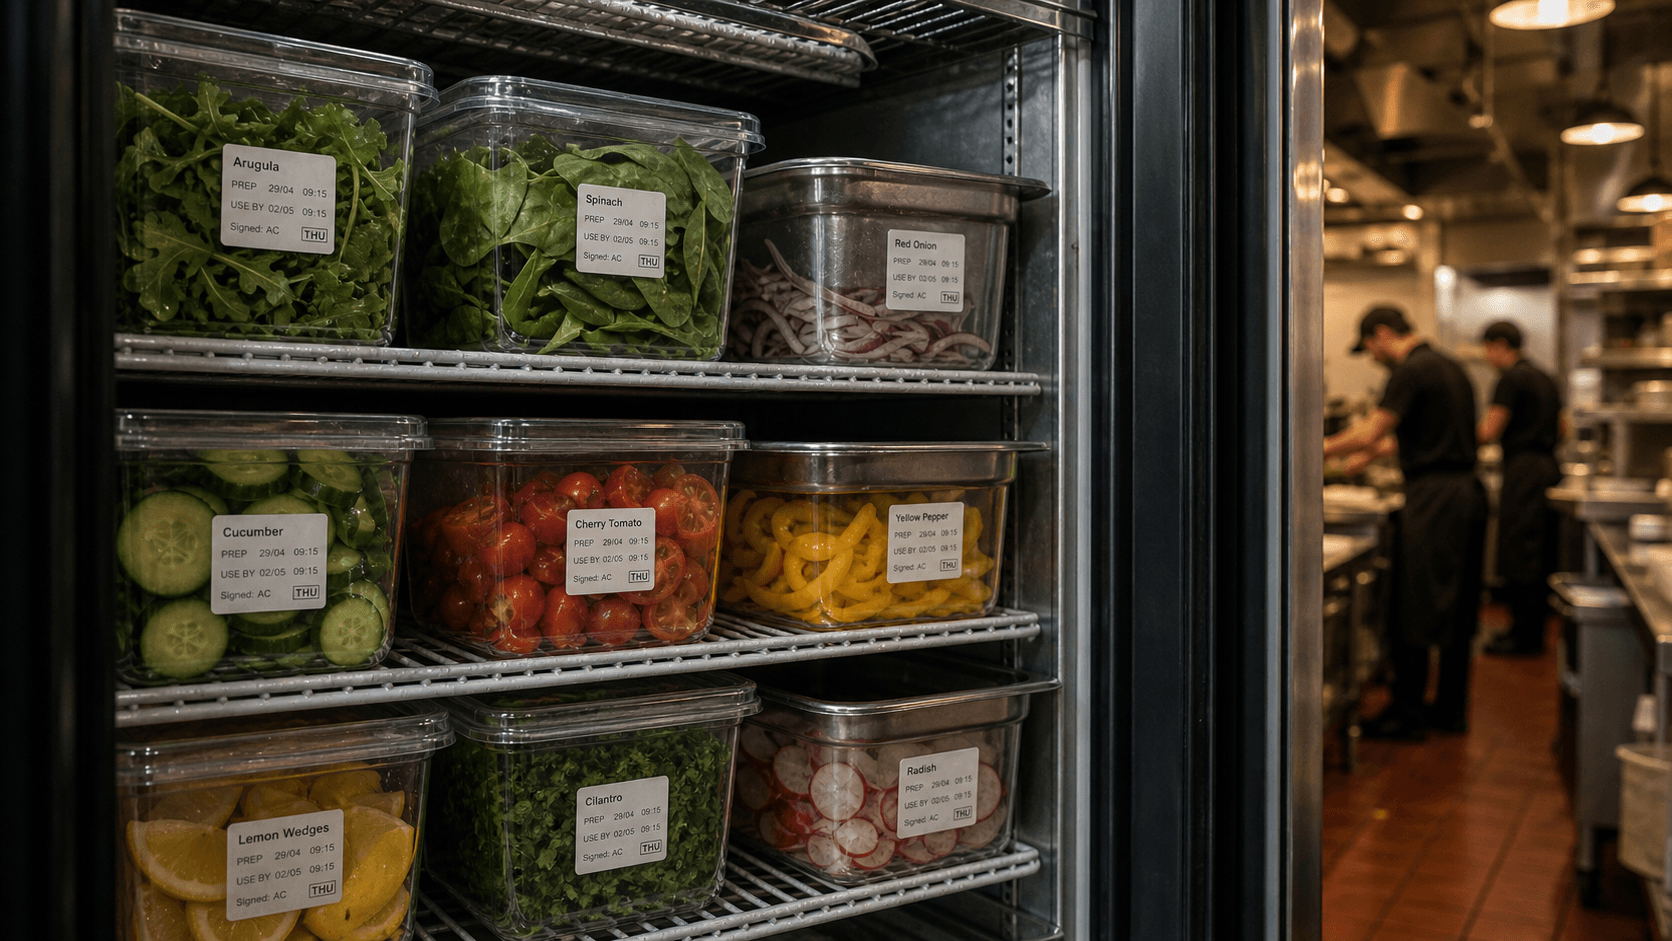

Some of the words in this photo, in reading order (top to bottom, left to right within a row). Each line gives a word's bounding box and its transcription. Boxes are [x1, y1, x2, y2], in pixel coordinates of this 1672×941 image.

[233, 157, 279, 172] Arugula
[231, 180, 257, 190] PREP
[268, 184, 294, 194] 29/04
[302, 188, 327, 198] 09:15
[586, 194, 623, 207] Spinach
[230, 201, 250, 210] USE
[252, 203, 264, 211] BY
[268, 205, 294, 214] 02/05
[302, 208, 327, 218] 09:15
[230, 222, 263, 234] Signed:
[266, 226, 280, 234] AC
[584, 215, 604, 223] PREP
[639, 221, 659, 229] 09:15
[304, 230, 325, 240] THU
[584, 233, 599, 241] USE
[613, 236, 633, 244] 02/05
[639, 238, 659, 246] 09:15
[894, 239, 911, 248] Red
[913, 240, 937, 250] Onion
[584, 252, 609, 261] Signed:
[641, 257, 658, 266] THU
[893, 257, 911, 265] PREP
[941, 260, 959, 268] 0915
[895, 514, 921, 522] Yellow
[923, 512, 949, 523] Pepper
[575, 519, 606, 530] Cherry
[609, 518, 642, 528] Tomato
[223, 527, 284, 538] Cucumber
[941, 529, 957, 537] 0915
[574, 539, 594, 547] PREP
[603, 538, 623, 546] 29/04
[629, 537, 649, 545] 09:15
[221, 550, 247, 558] PREP
[259, 549, 285, 557] 29/04
[294, 548, 318, 556] 09:15
[603, 555, 623, 563] 02/05
[221, 570, 240, 578] USE
[259, 568, 286, 577] 02/05
[293, 567, 318, 575] 09:15
[573, 575, 599, 584] Signed:
[221, 591, 254, 601] Signed:
[257, 590, 271, 598] AC
[296, 588, 317, 597] THU
[907, 764, 937, 776] Radish
[905, 784, 924, 793] PREP
[954, 775, 972, 785] 0915
[585, 794, 623, 806] Cilantro
[904, 801, 918, 809] USE
[920, 799, 928, 807] BY
[954, 791, 972, 800] 0915
[584, 815, 604, 825] PREP
[641, 806, 661, 816] 09:15
[956, 809, 970, 818] THU
[904, 816, 926, 827] Signed
[929, 814, 939, 822] AC
[239, 832, 279, 845] Lemon
[283, 824, 329, 838] Wedges
[583, 834, 599, 843] USE
[600, 832, 610, 841] BY
[614, 828, 635, 838] 02/05
[642, 842, 660, 852] THU
[236, 855, 263, 866] PREP
[310, 843, 335, 854] 09:15
[583, 851, 610, 862] Signed:
[612, 848, 623, 856] AC
[236, 875, 255, 886] USE
[258, 873, 271, 882] BY
[275, 868, 301, 879] 02/05
[309, 863, 335, 873] 09:15
[312, 884, 334, 895] THU
[236, 894, 270, 907] Signed:
[273, 891, 287, 900] AC
